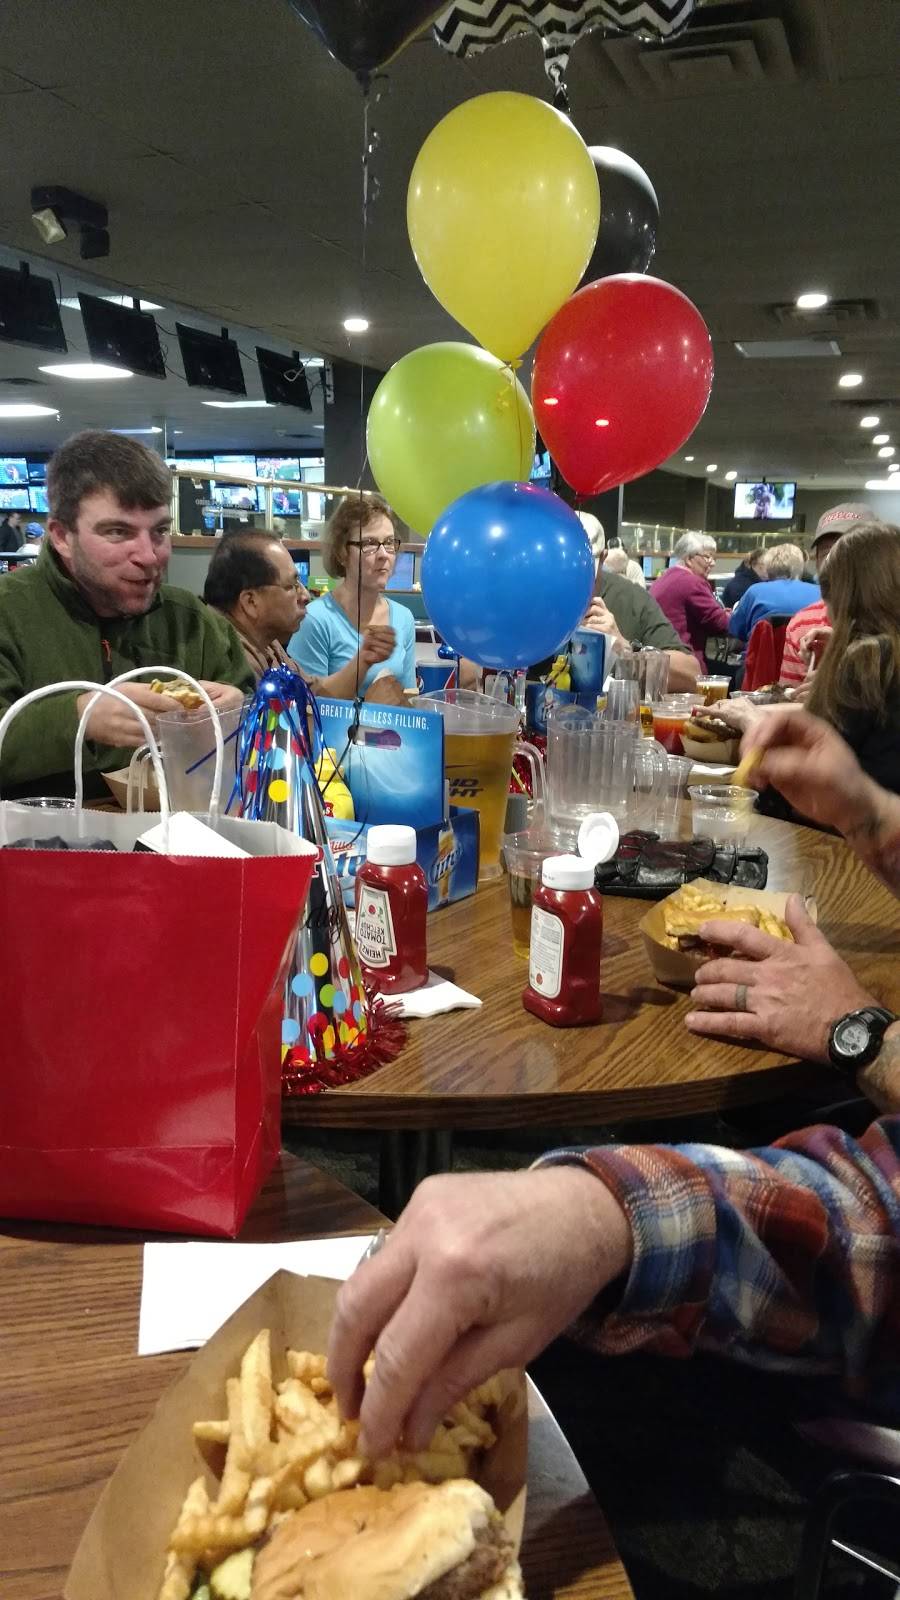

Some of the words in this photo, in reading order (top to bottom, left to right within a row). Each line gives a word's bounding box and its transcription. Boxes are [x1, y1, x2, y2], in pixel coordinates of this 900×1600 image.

[320, 704, 343, 718] GREAT
[373, 710, 393, 725] LESS
[395, 712, 430, 730] FILLING.
[361, 921, 385, 936] KETCHUP
[360, 929, 387, 945] TOMATO
[362, 945, 382, 959] HEINZ
